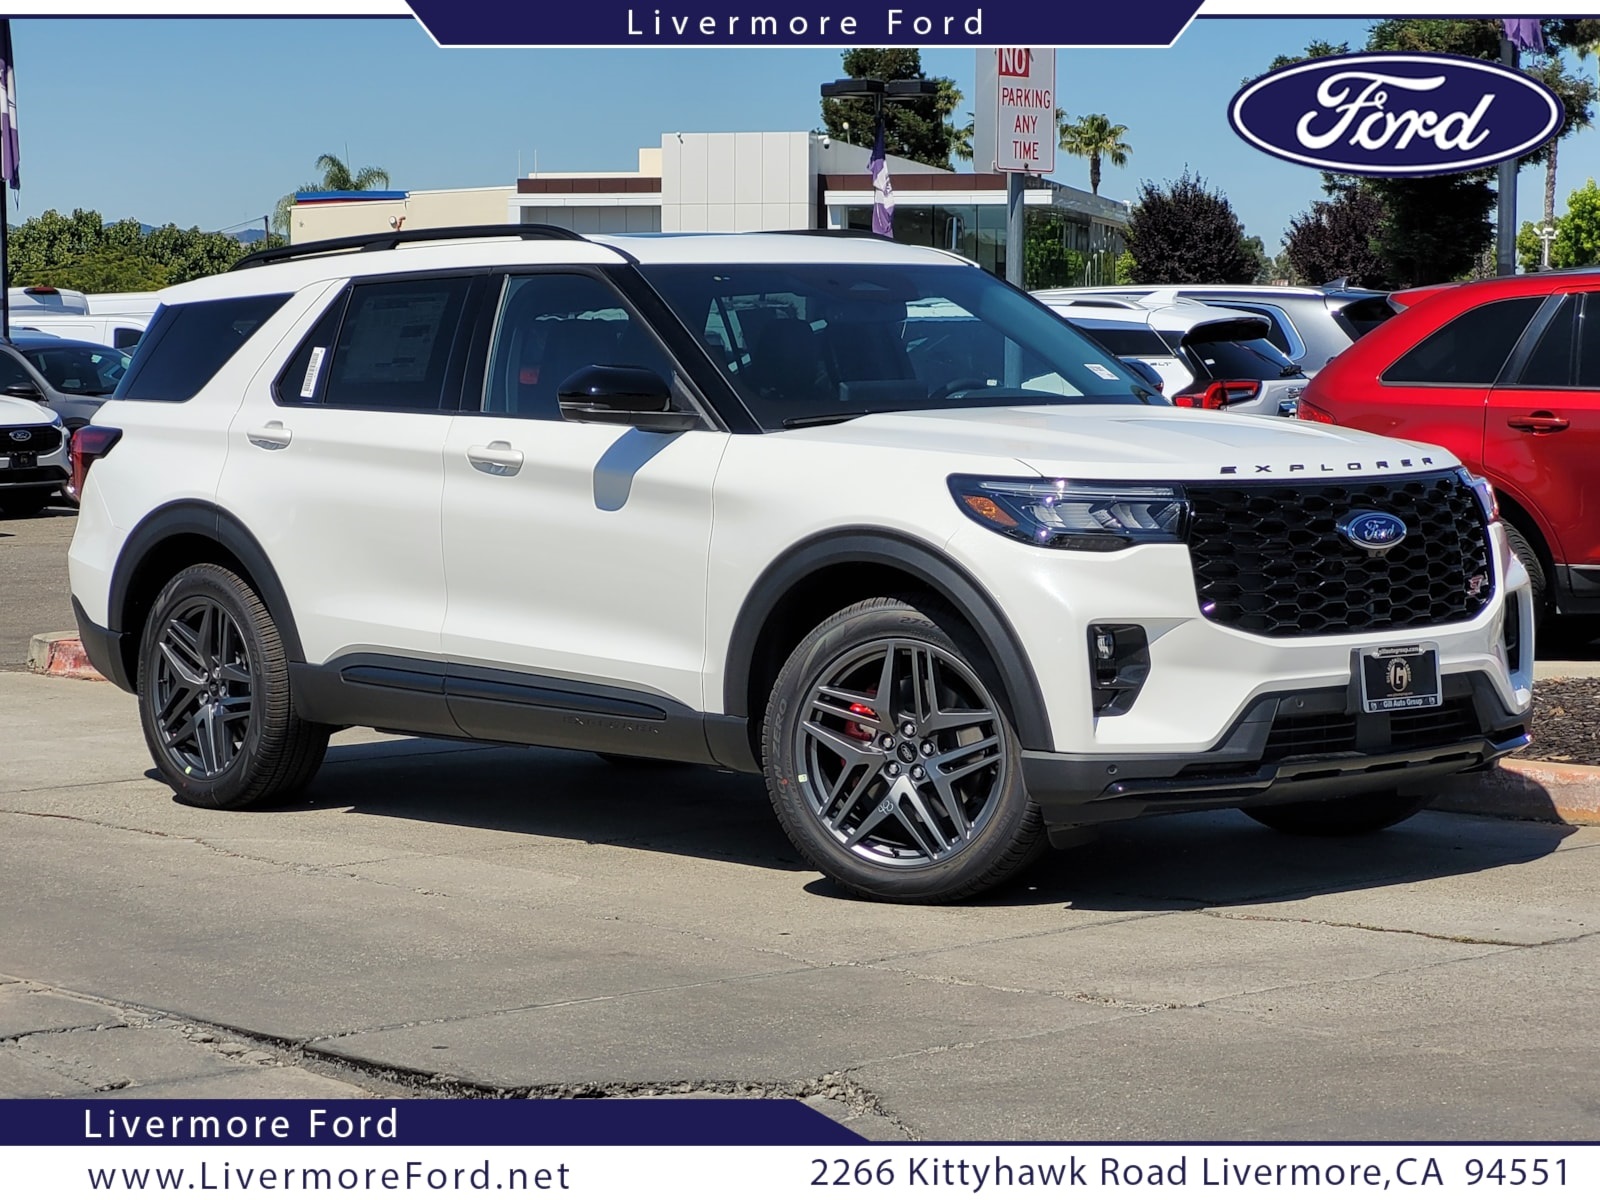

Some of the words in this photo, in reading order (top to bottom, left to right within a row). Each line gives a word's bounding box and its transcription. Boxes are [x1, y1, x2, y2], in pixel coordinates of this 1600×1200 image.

[1001, 48, 1027, 74] NO
[1001, 87, 1051, 110] PARKING
[1014, 114, 1038, 134] ANY
[1012, 140, 1040, 161] TIME
[1219, 457, 1434, 475] EXPLORER
